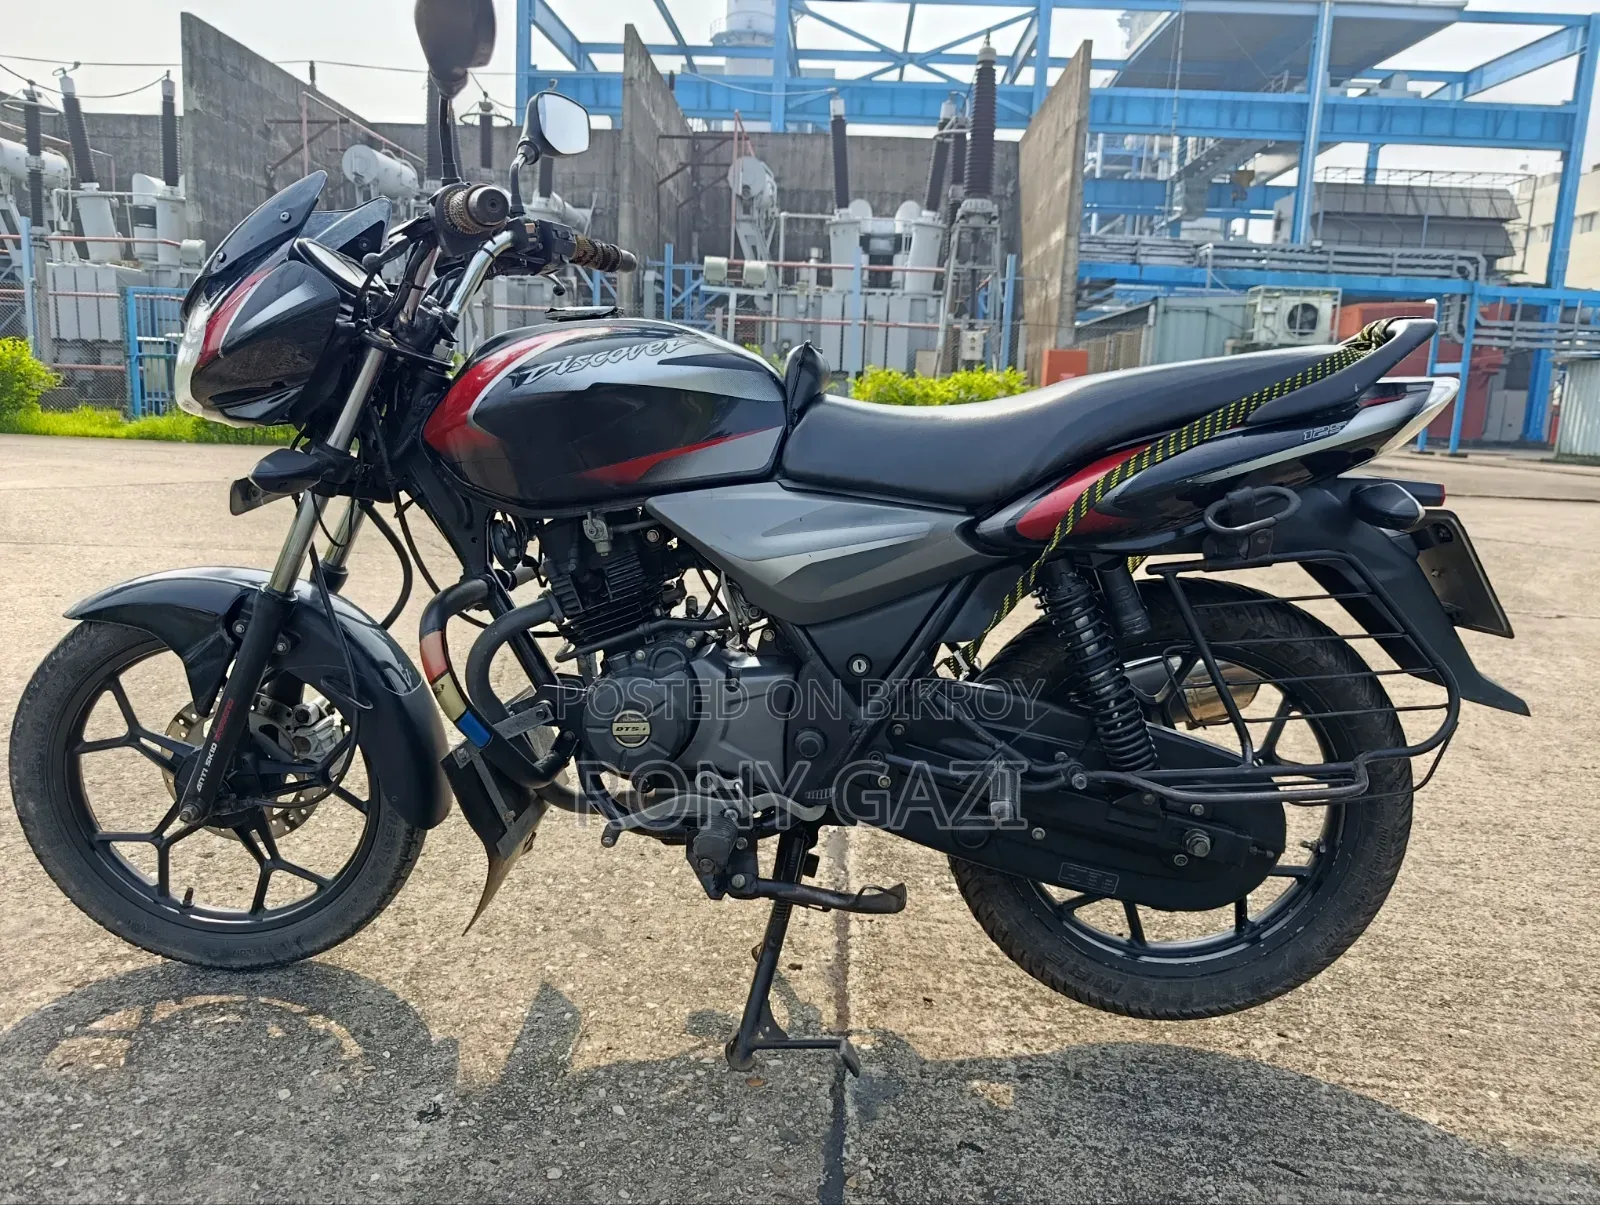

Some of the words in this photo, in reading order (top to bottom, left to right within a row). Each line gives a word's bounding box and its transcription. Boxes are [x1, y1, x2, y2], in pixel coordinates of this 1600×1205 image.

[519, 337, 698, 385] Discover
[1303, 420, 1347, 440] 125
[196, 768, 209, 793] ANTI
[205, 742, 218, 768] SKID
